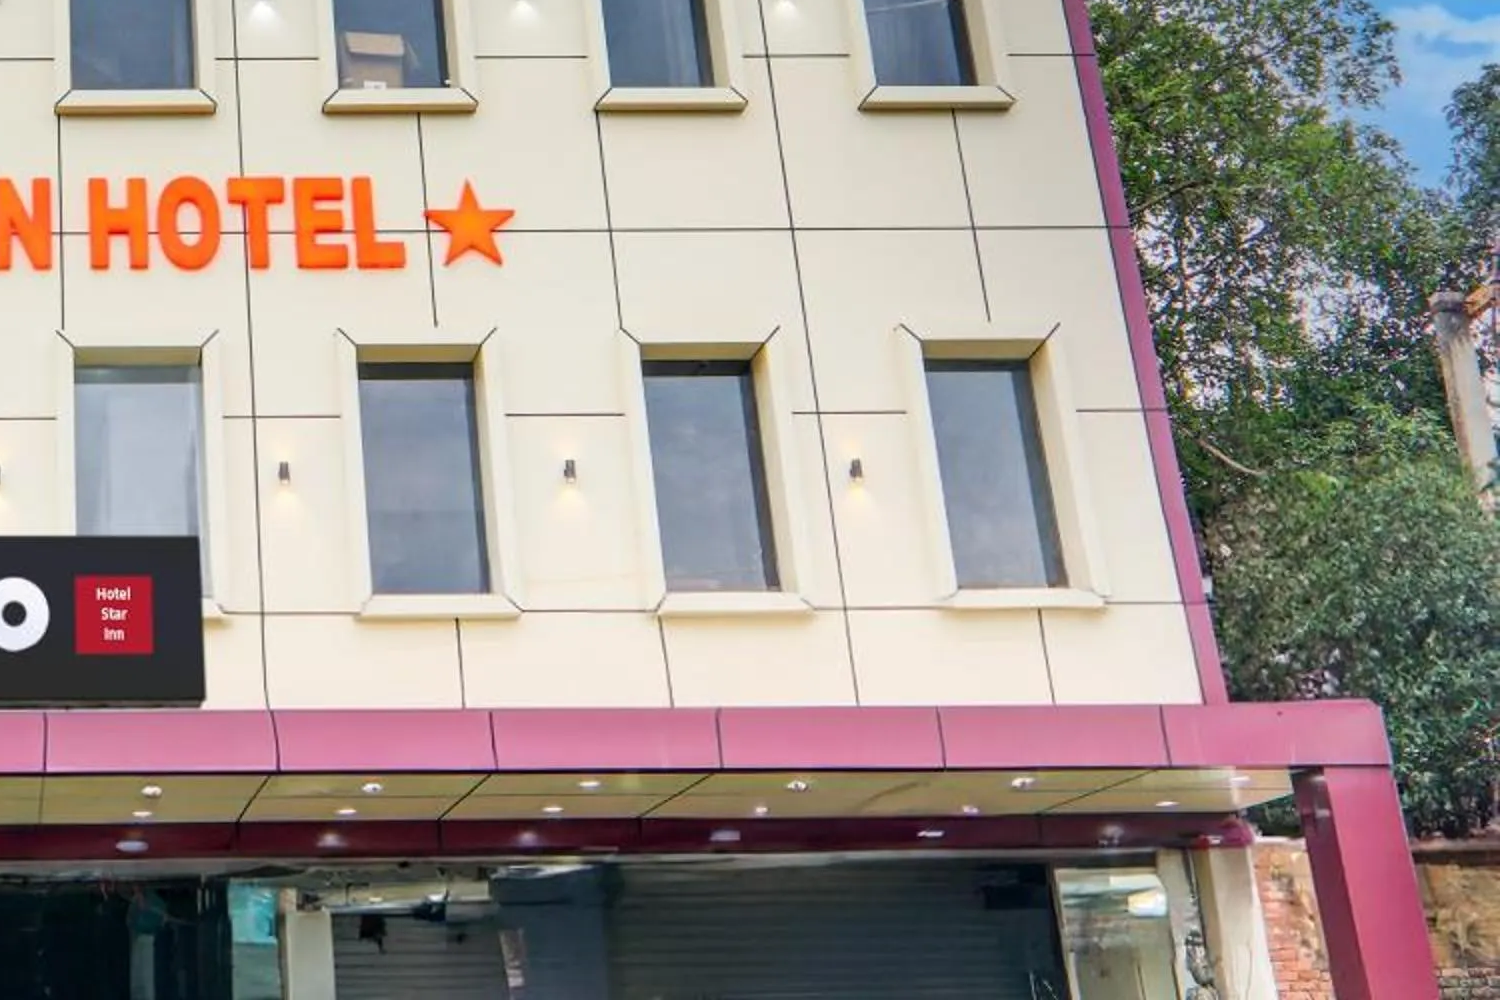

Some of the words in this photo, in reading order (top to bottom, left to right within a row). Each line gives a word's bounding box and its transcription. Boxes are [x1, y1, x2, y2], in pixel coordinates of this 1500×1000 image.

[87, 174, 407, 273] HOTEL
[95, 586, 132, 601] Hotel
[100, 607, 129, 621] Star
[103, 627, 126, 641] Inn
